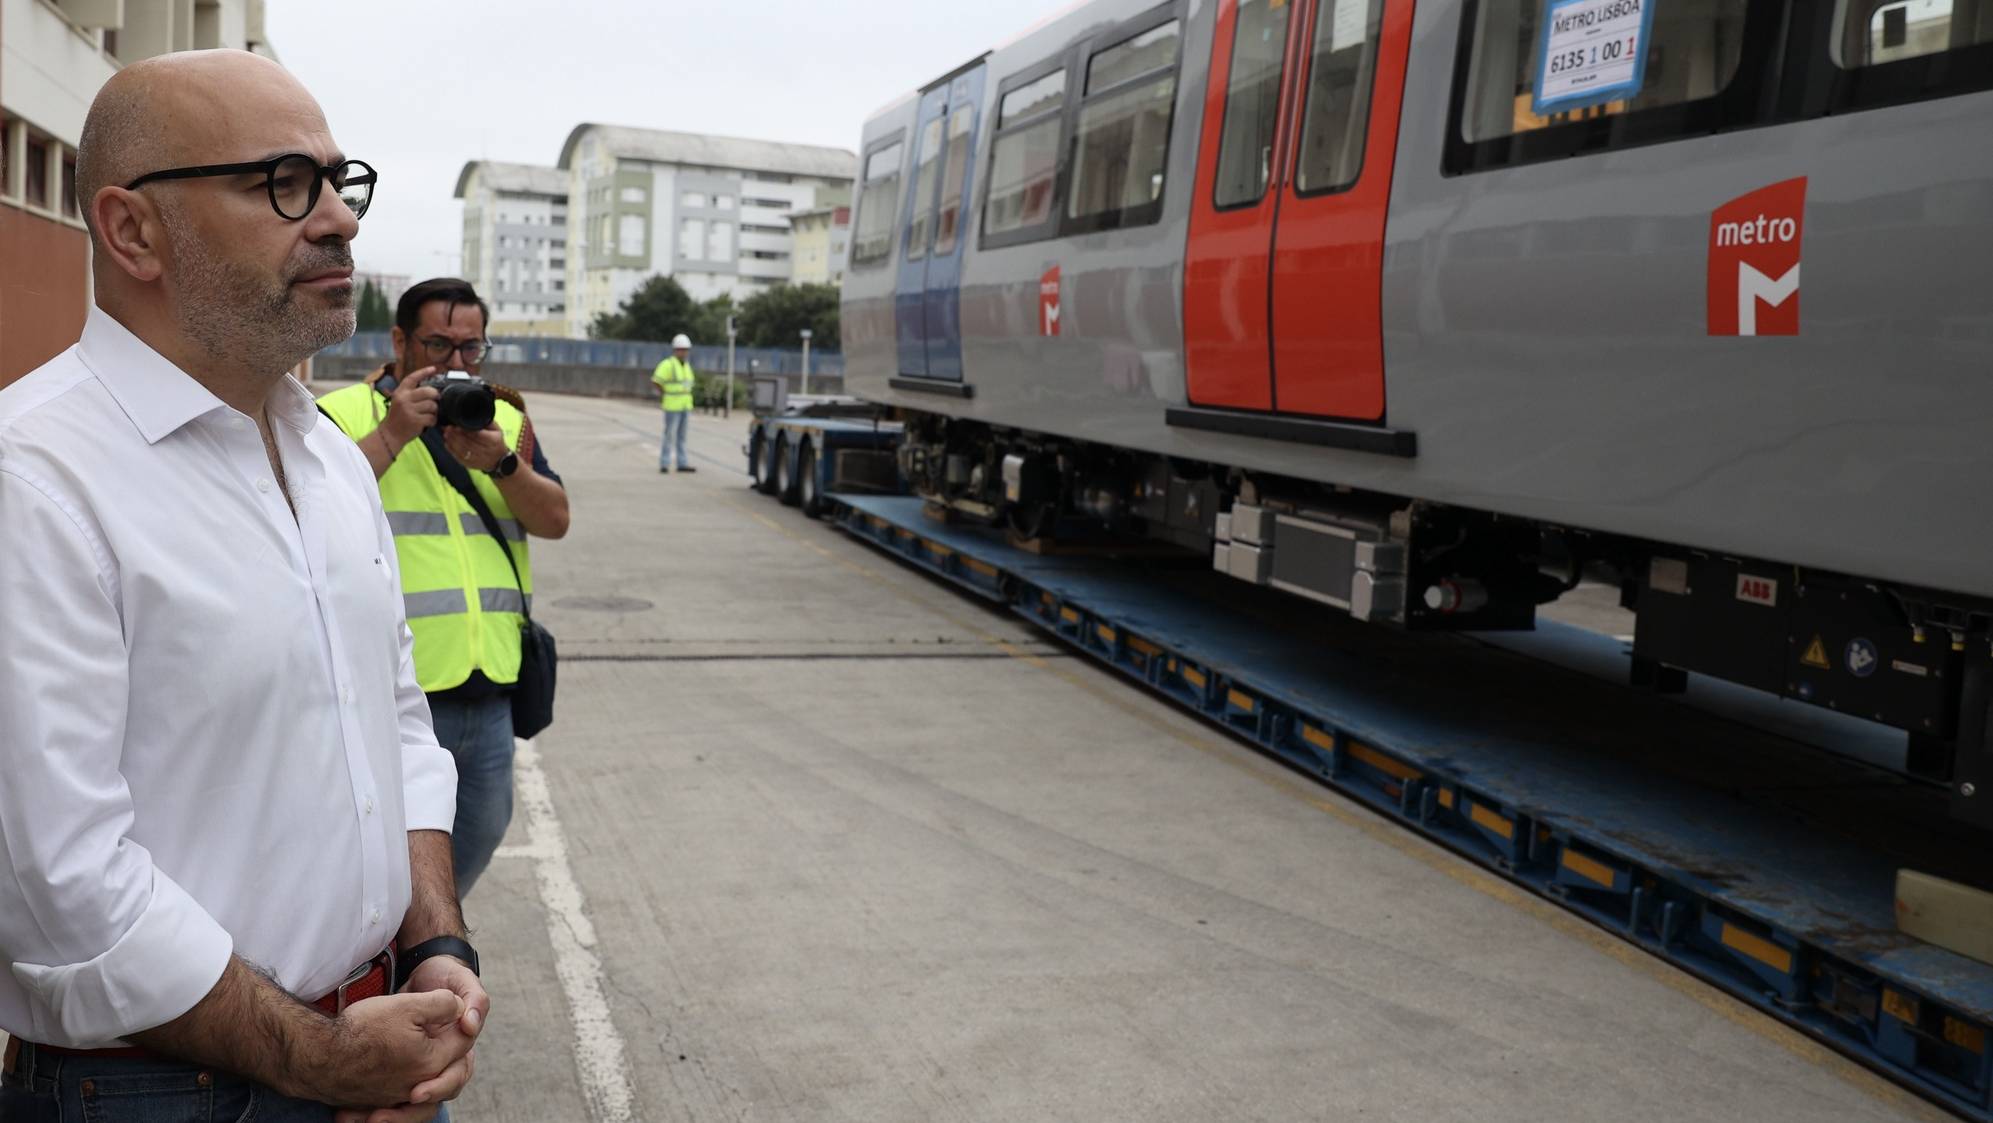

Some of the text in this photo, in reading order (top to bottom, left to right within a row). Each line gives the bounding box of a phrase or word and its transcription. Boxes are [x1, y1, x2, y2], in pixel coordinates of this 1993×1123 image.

[1553, 0, 1640, 35] METRO LISBOA
[1550, 36, 1635, 73] 6135 1 00 1
[1716, 213, 1796, 247] metro
[1741, 579, 1771, 600] ABB
